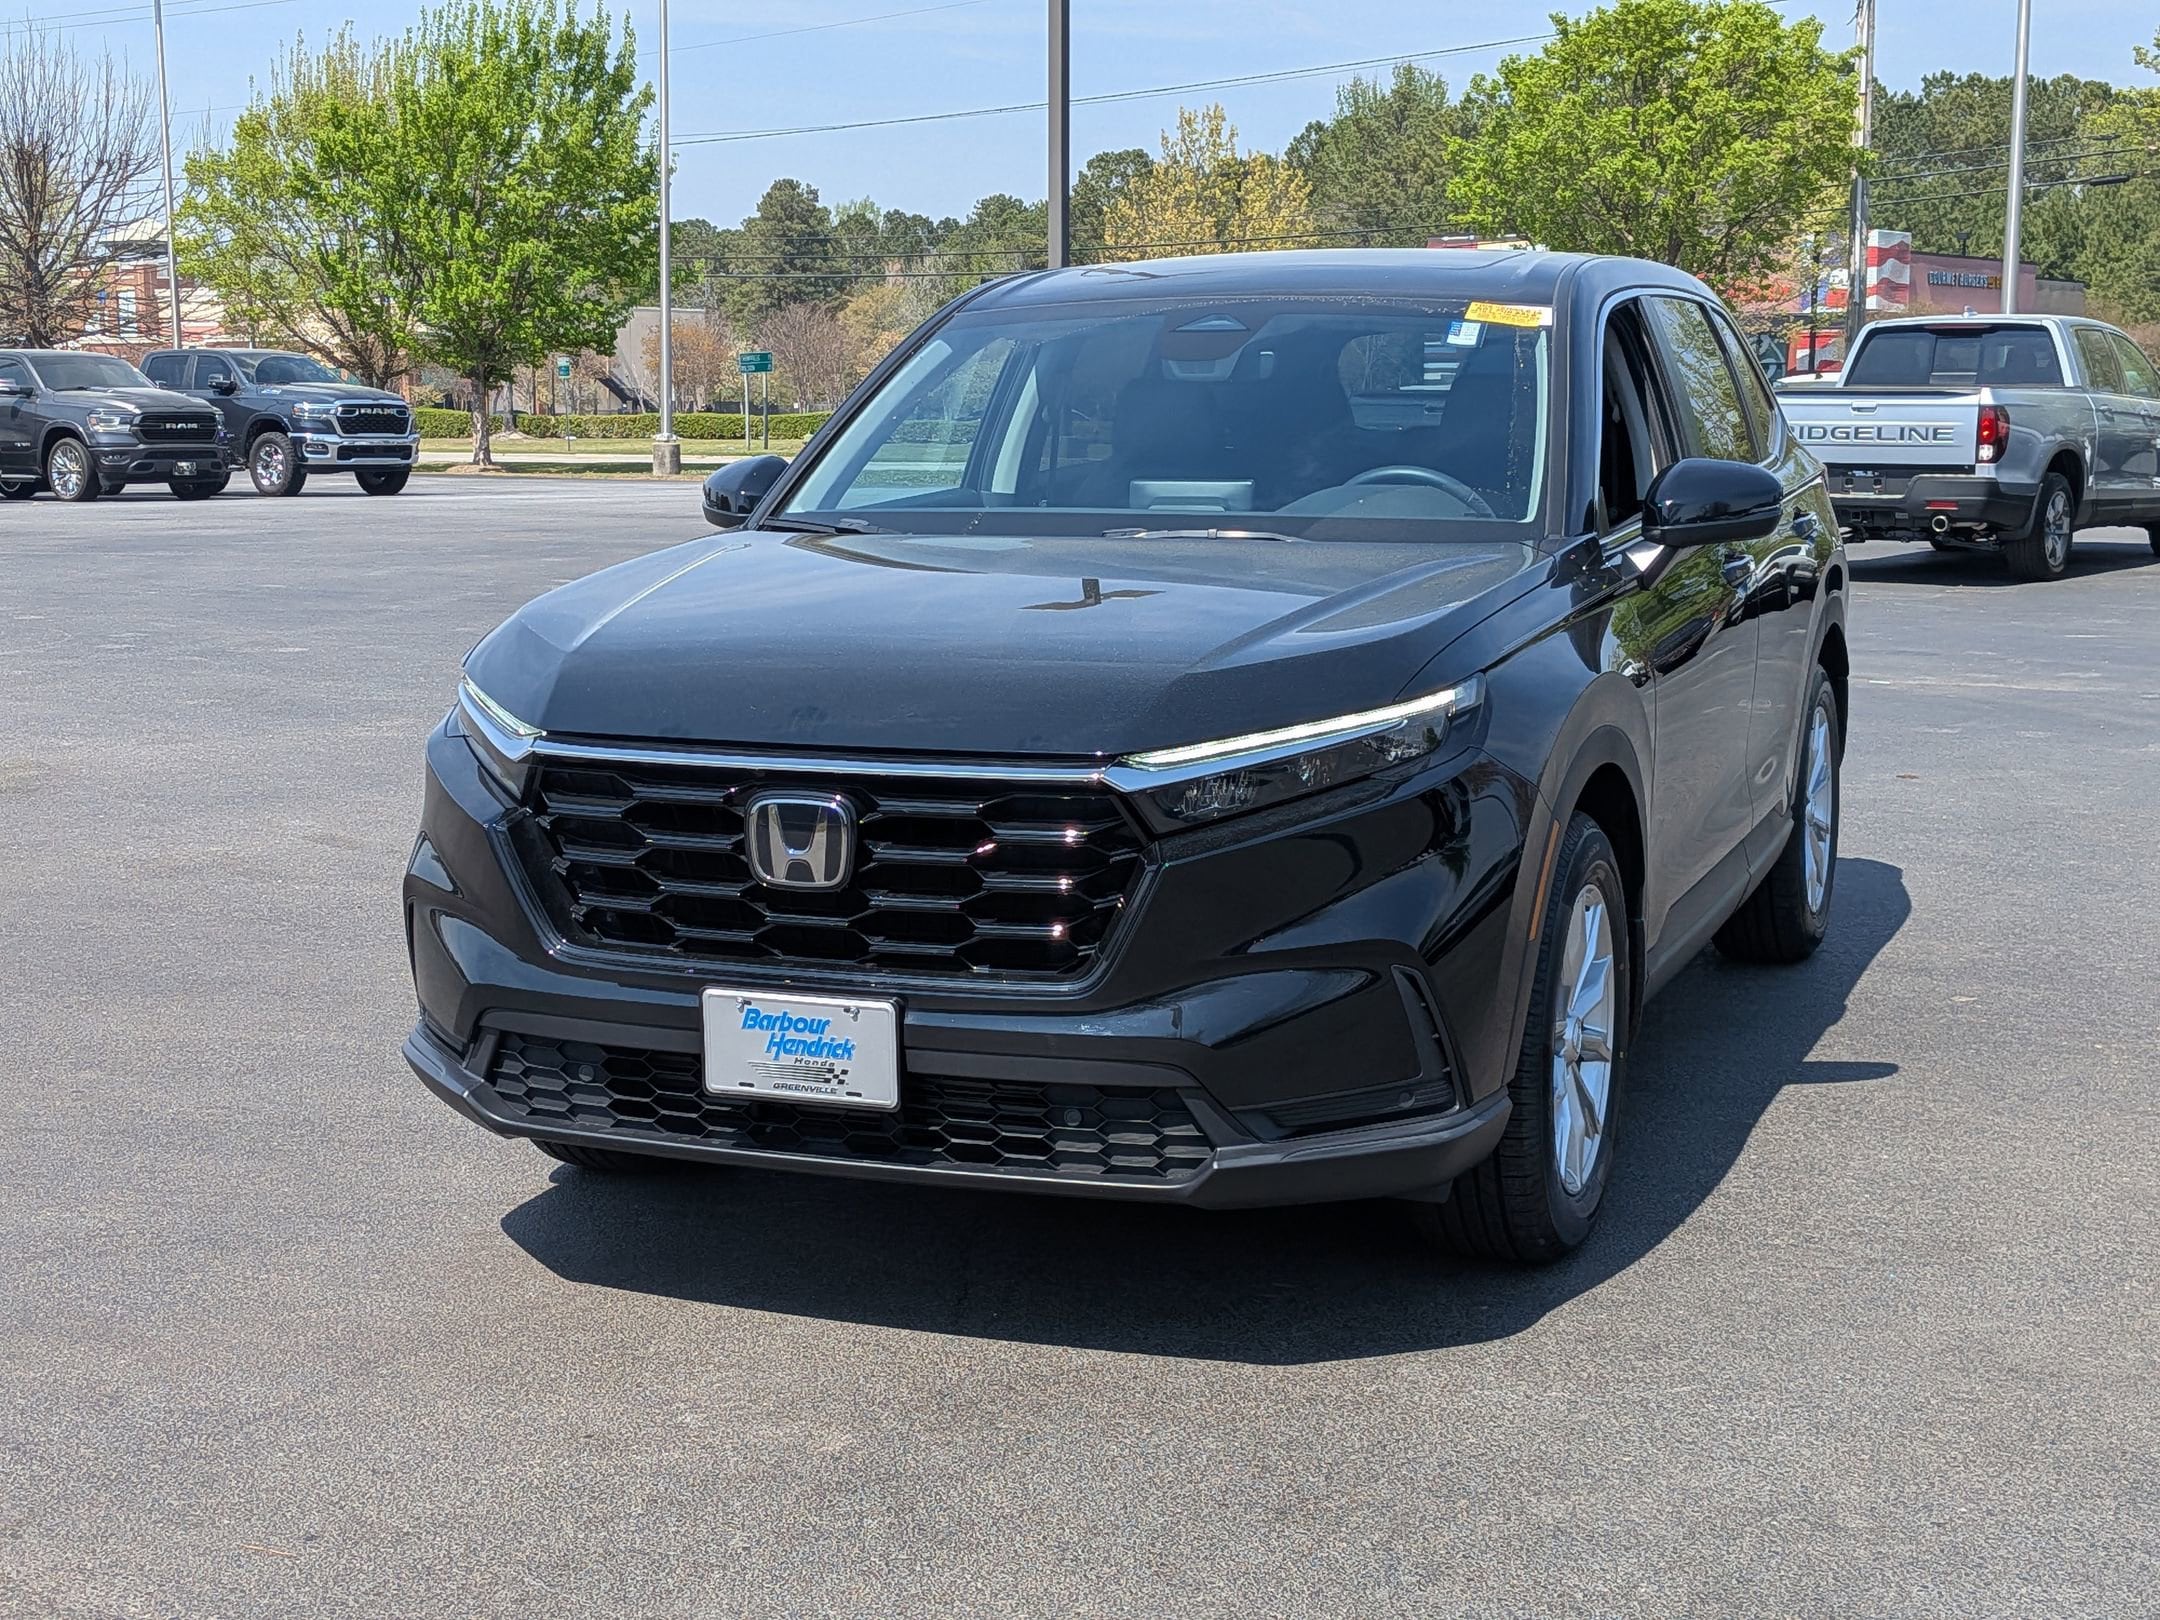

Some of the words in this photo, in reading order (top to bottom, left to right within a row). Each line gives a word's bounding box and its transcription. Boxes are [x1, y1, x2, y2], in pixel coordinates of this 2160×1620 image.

[360, 407, 396, 416] RAM
[165, 422, 199, 430] RAM
[1790, 426, 1955, 443] IDGELINE
[741, 1007, 832, 1035] Barbour
[765, 1032, 857, 1062] Hendrick
[793, 1056, 836, 1068] Honda
[772, 1081, 839, 1095] GREENVILLE
